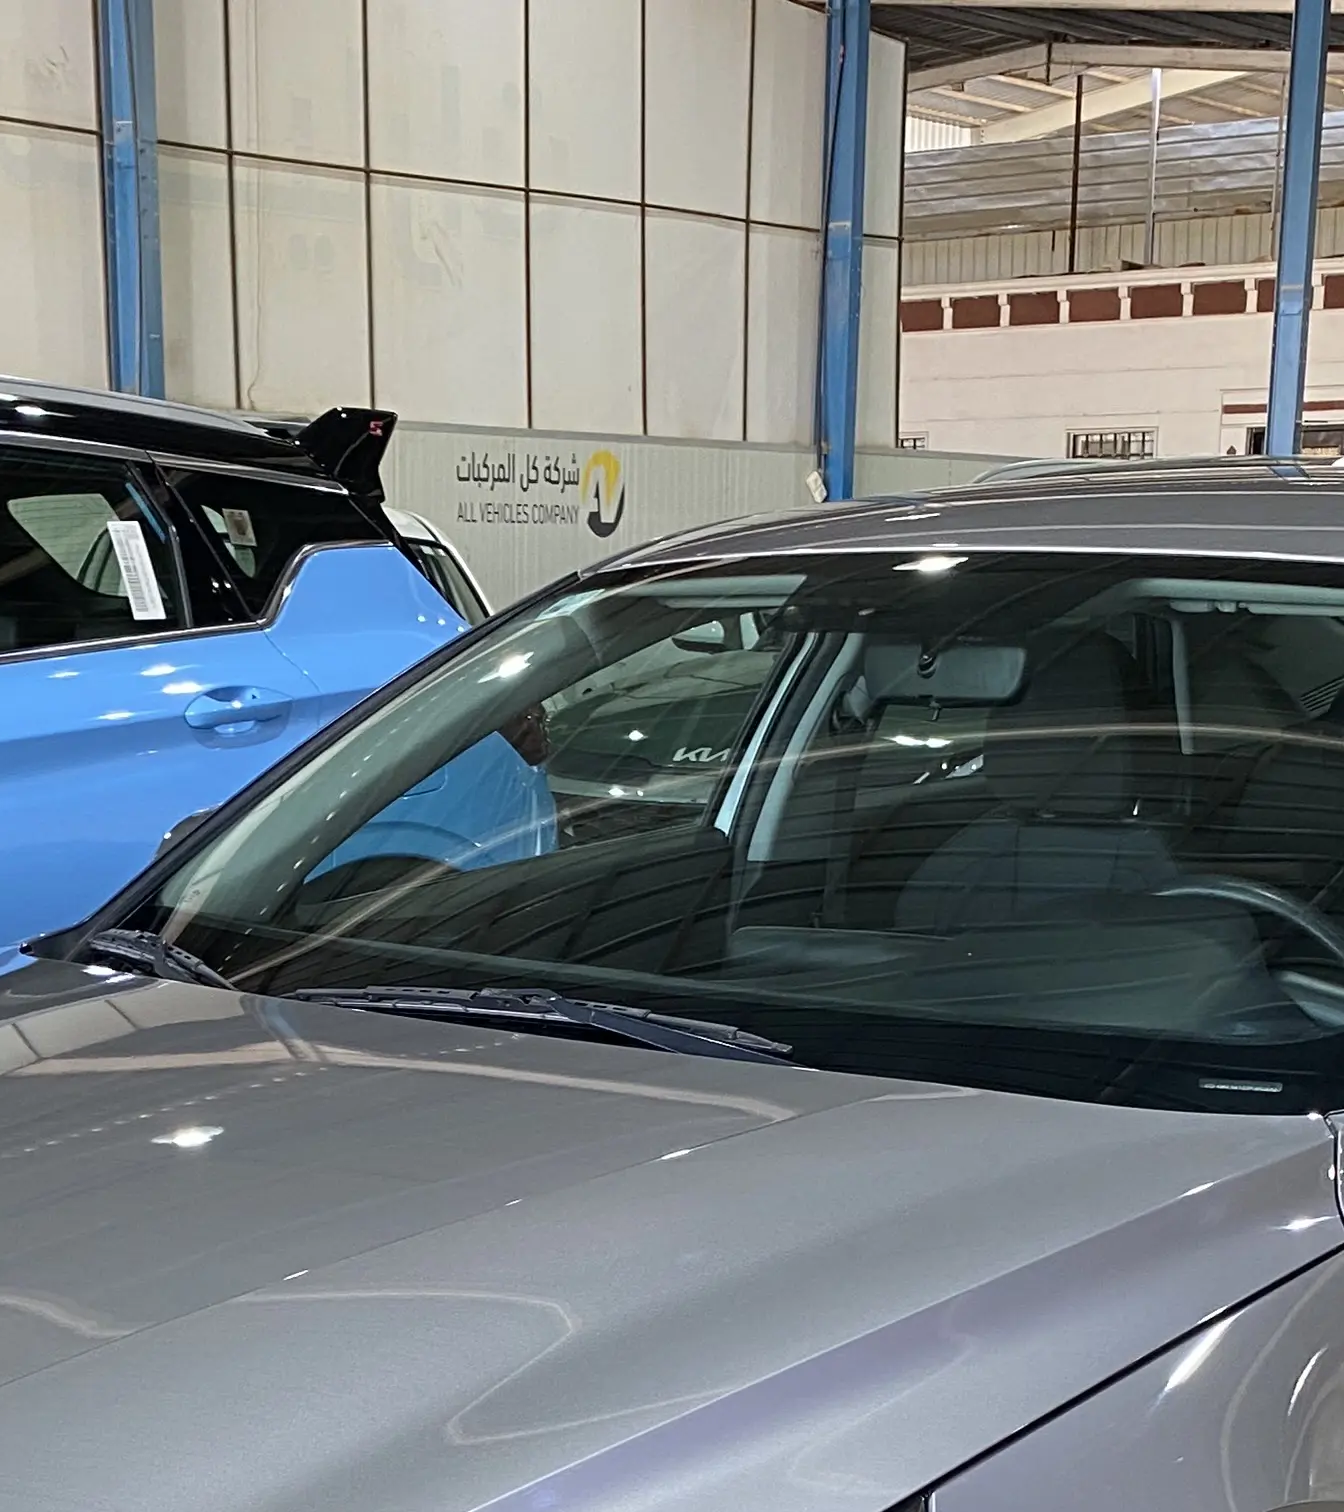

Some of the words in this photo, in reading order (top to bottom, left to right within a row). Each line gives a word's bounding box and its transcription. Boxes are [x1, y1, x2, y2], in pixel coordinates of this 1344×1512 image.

[455, 451, 517, 492] المركبات
[519, 454, 540, 493] كل
[543, 453, 581, 494] شركة
[456, 501, 478, 523] ALL
[480, 502, 529, 525] VEHICLES
[531, 504, 580, 526] COMPANY
